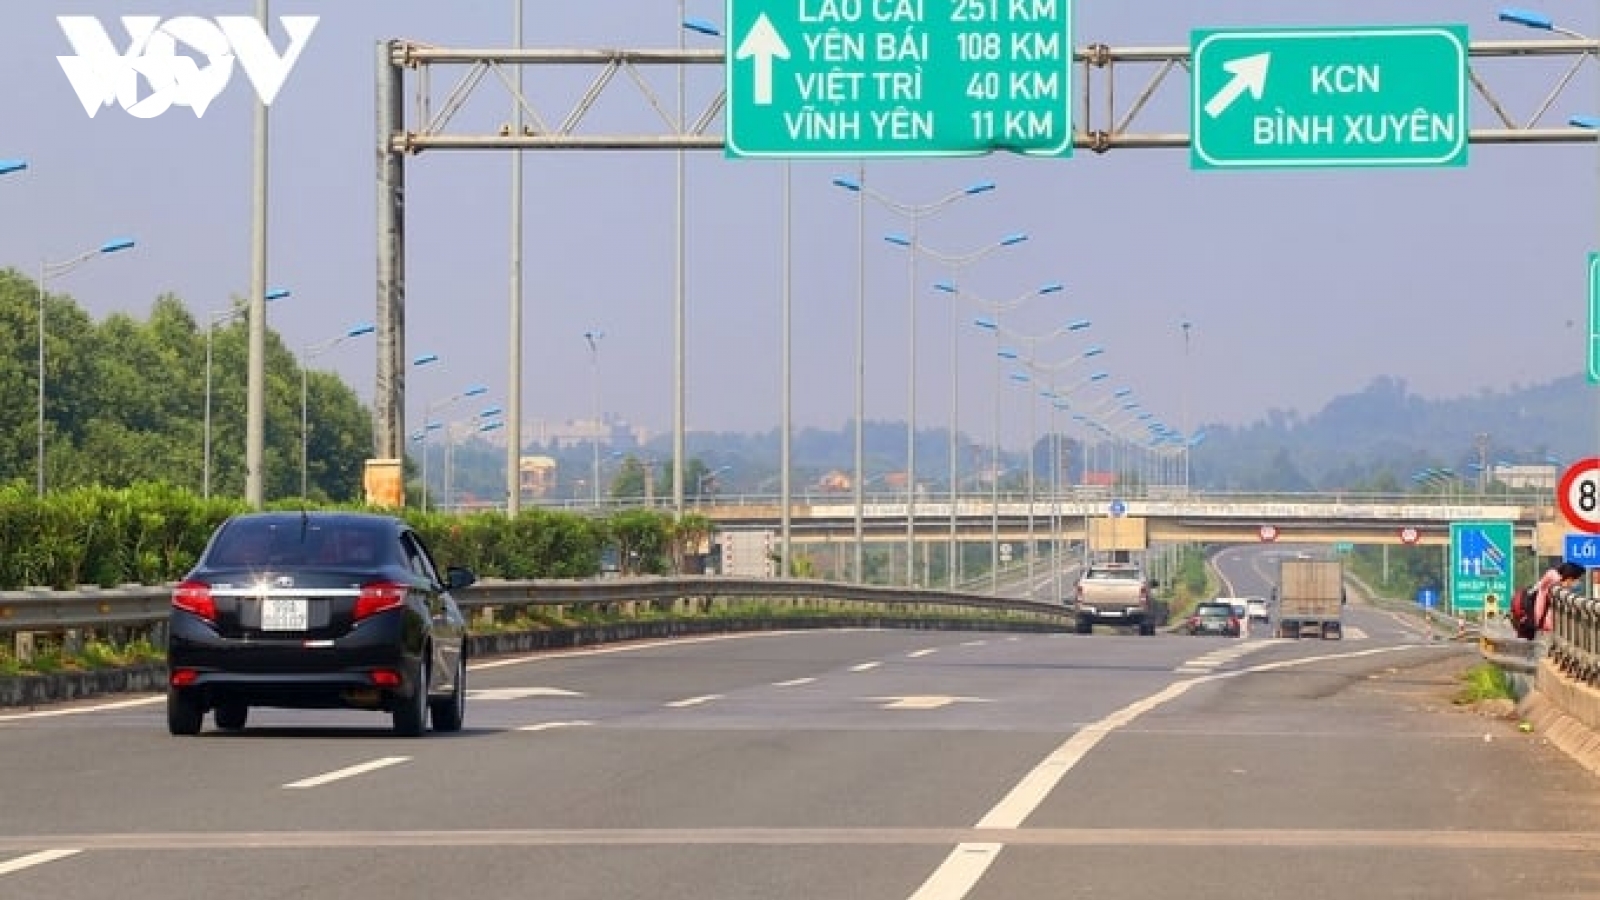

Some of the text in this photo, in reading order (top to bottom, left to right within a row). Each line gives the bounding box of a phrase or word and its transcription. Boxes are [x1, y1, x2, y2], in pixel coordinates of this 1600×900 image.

[951, 0, 997, 22] 251
[1009, 0, 1057, 21] KM
[804, 26, 1059, 60] YÊN BÁI 108 KM
[795, 66, 1058, 105] VIỆT TRÌ 40 KM
[1312, 64, 1380, 93] KCN
[784, 106, 1053, 140] VĨNH YÊN 11 KM
[1253, 107, 1455, 145] BÌNH XUYÊN
[1573, 538, 1596, 559] LỐI
